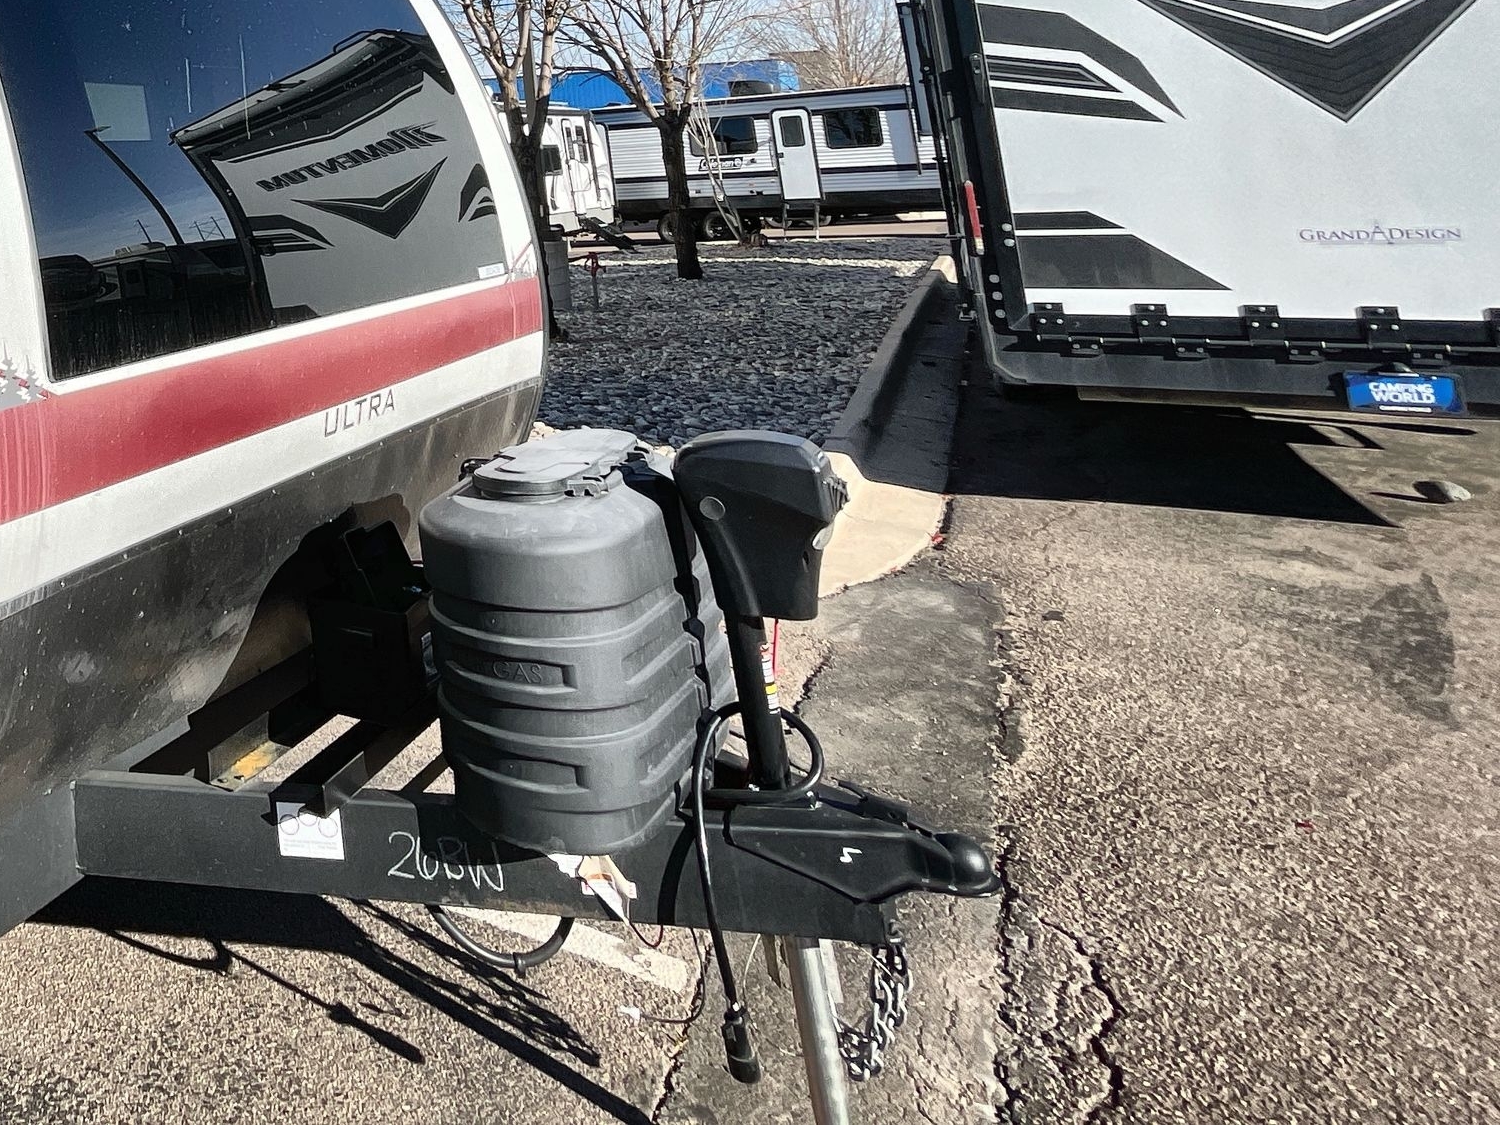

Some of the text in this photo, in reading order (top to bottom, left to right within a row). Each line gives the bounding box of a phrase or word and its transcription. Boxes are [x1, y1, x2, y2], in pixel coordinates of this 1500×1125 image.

[1299, 227, 1462, 241] GRAND DESIGN
[1371, 391, 1436, 404] WORLD
[324, 388, 395, 437] ULTRA
[493, 661, 542, 684] GAS
[387, 831, 504, 892] 26BW
